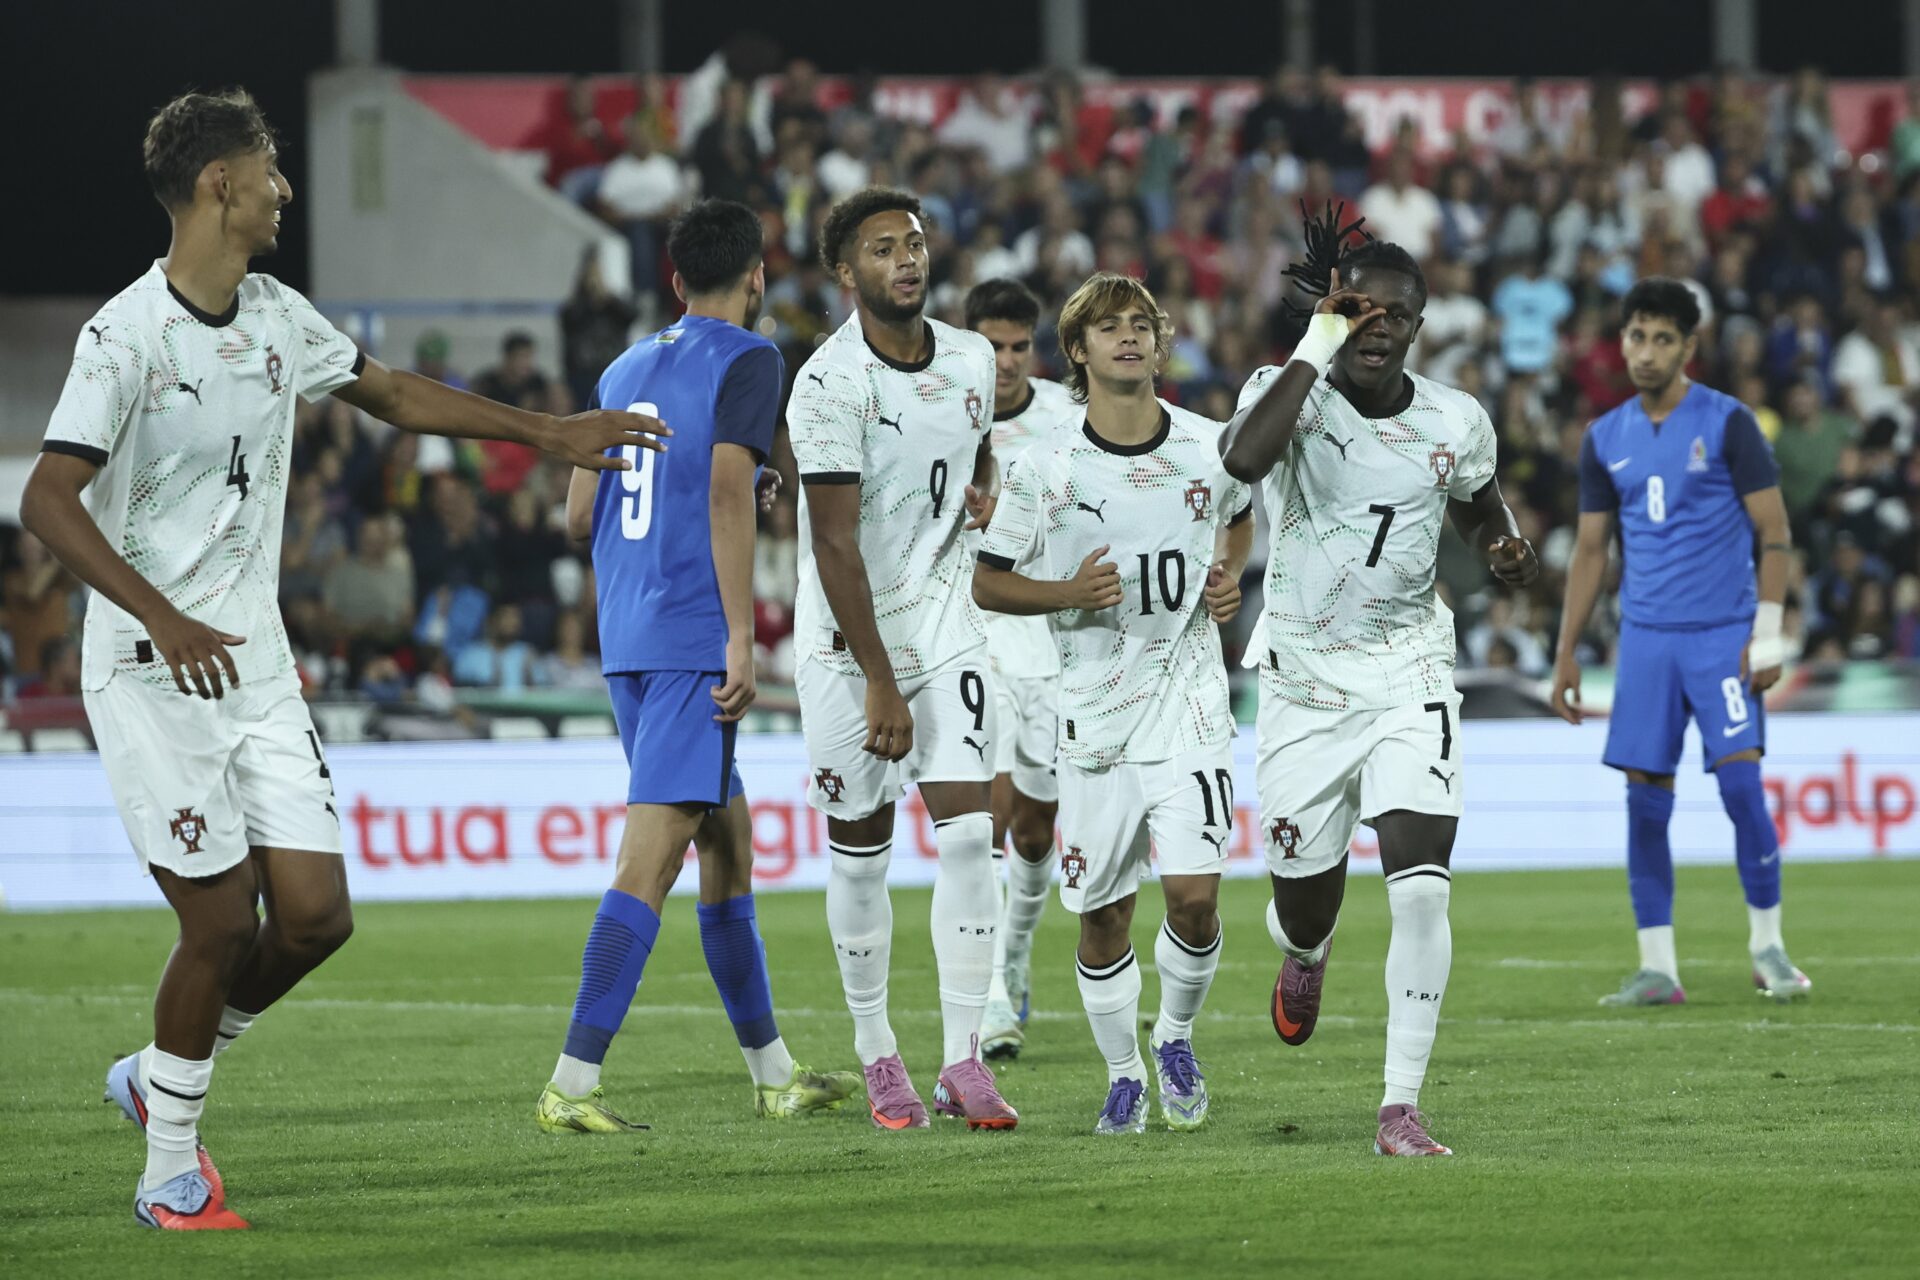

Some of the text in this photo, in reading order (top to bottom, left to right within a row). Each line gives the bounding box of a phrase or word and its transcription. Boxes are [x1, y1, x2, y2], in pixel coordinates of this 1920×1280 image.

[226, 434, 250, 501] 4
[621, 402, 658, 540] 9
[929, 458, 948, 518] 9
[1646, 475, 1666, 524] 8
[1364, 503, 1396, 568] 7
[1136, 548, 1186, 616] 10
[959, 670, 985, 731] 9
[1423, 701, 1452, 761] 7
[1720, 676, 1748, 723] 8
[349, 791, 509, 869] tua
[1190, 768, 1234, 831] 10
